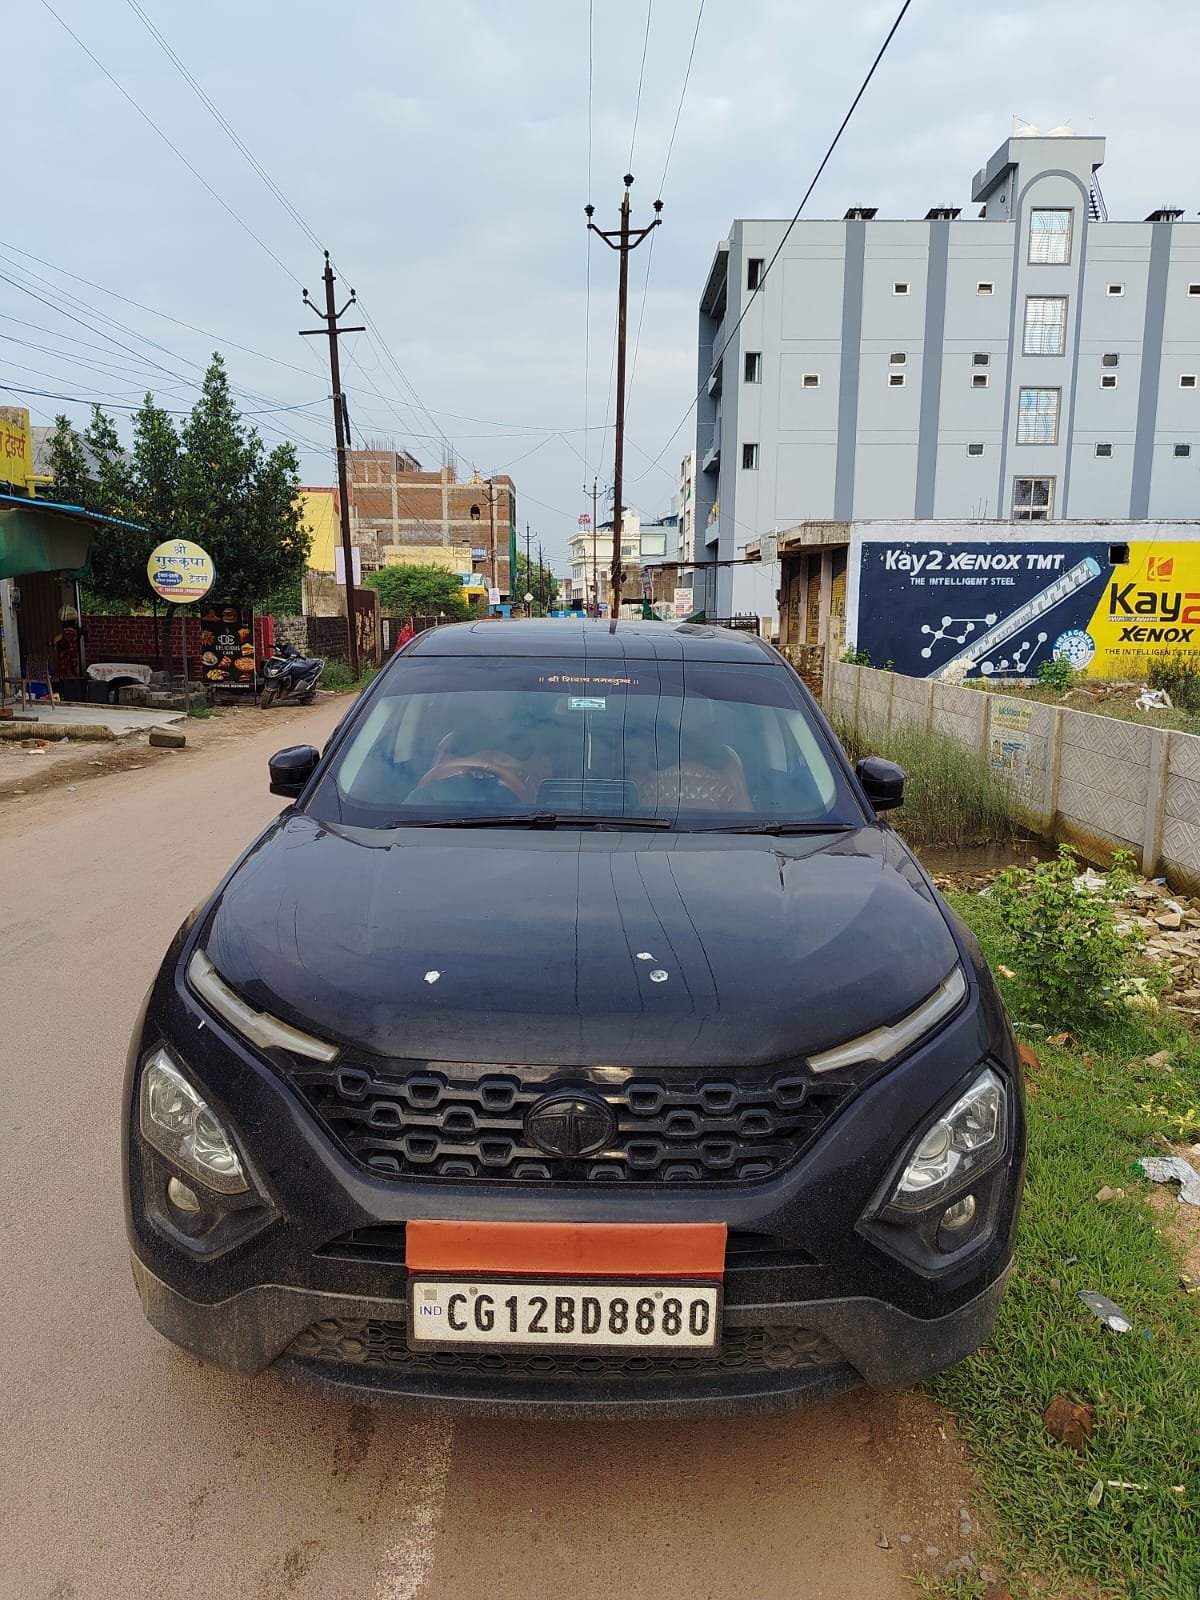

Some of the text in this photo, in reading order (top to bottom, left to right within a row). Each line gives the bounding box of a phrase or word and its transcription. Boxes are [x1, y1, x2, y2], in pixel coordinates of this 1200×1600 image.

[174, 542, 187, 555] श्री
[885, 549, 1065, 576] Kay2 XENOX TMT
[910, 577, 1016, 586] THE INTELLIGENT STEEL
[1053, 629, 1095, 650] HEXAGONAL
[1118, 625, 1195, 643] XENOX
[419, 1305, 442, 1317] IND
[447, 1293, 710, 1337] CG12BD8880
